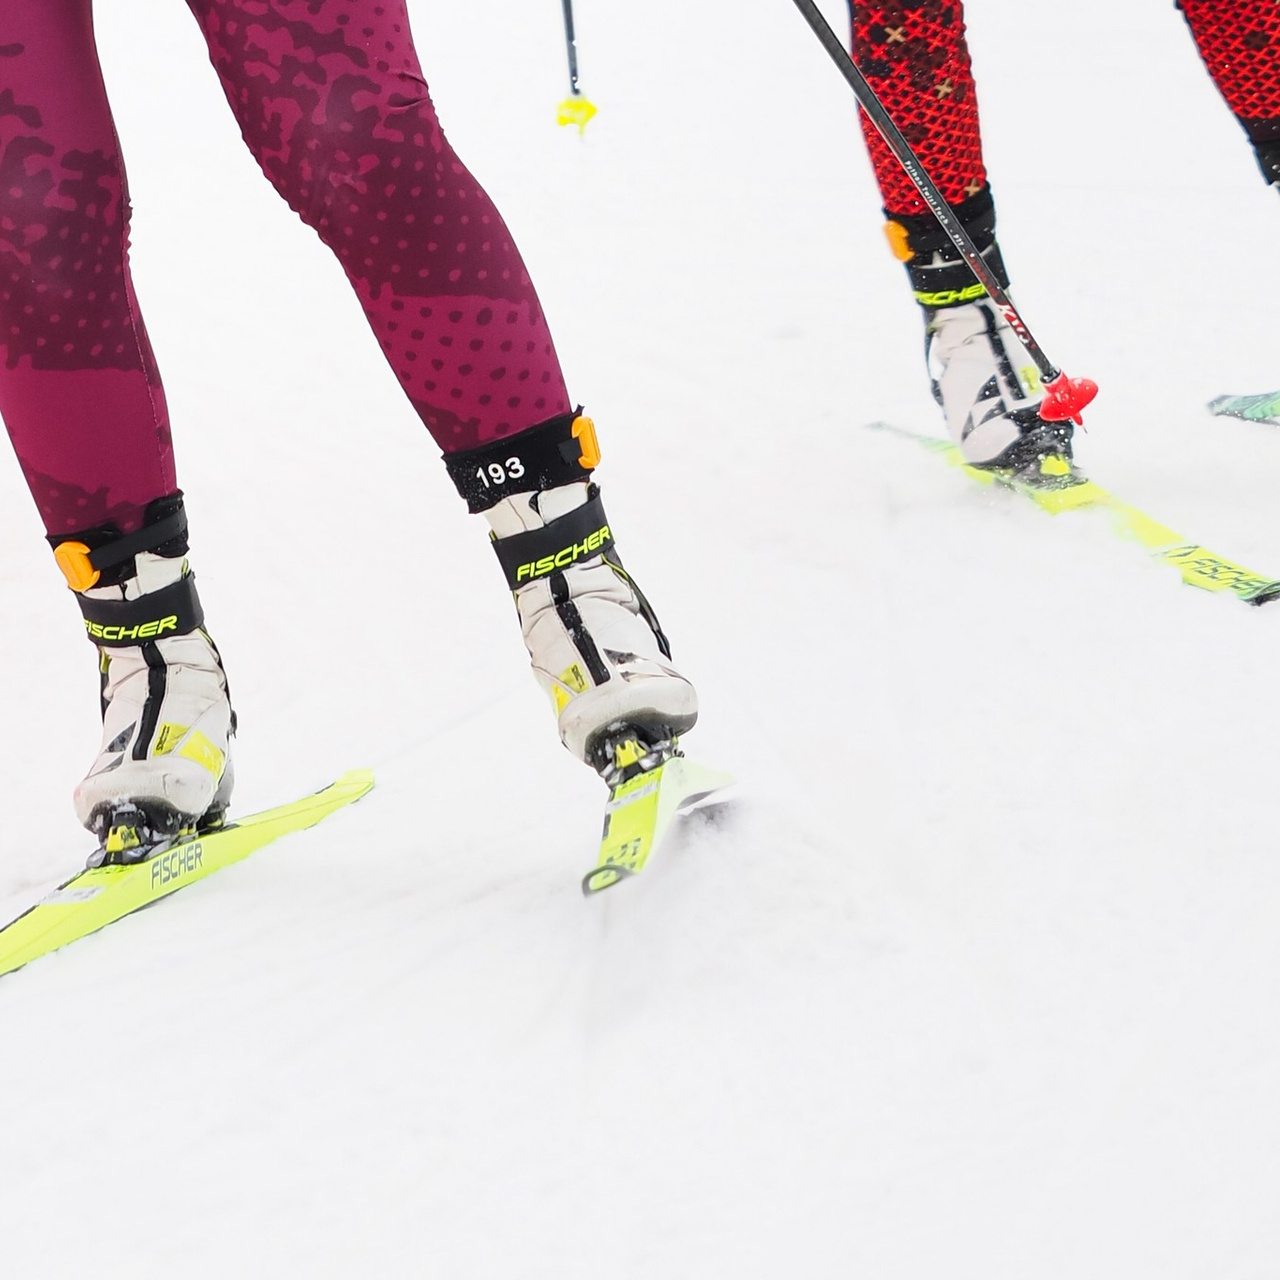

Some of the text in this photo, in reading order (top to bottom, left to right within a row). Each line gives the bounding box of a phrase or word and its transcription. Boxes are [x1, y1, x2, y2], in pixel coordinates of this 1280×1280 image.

[922, 186, 938, 206] Twist
[475, 456, 526, 489] 193
[516, 525, 611, 582] FISCHER
[83, 614, 178, 641] FISCHER
[151, 842, 204, 891] FISCHER
